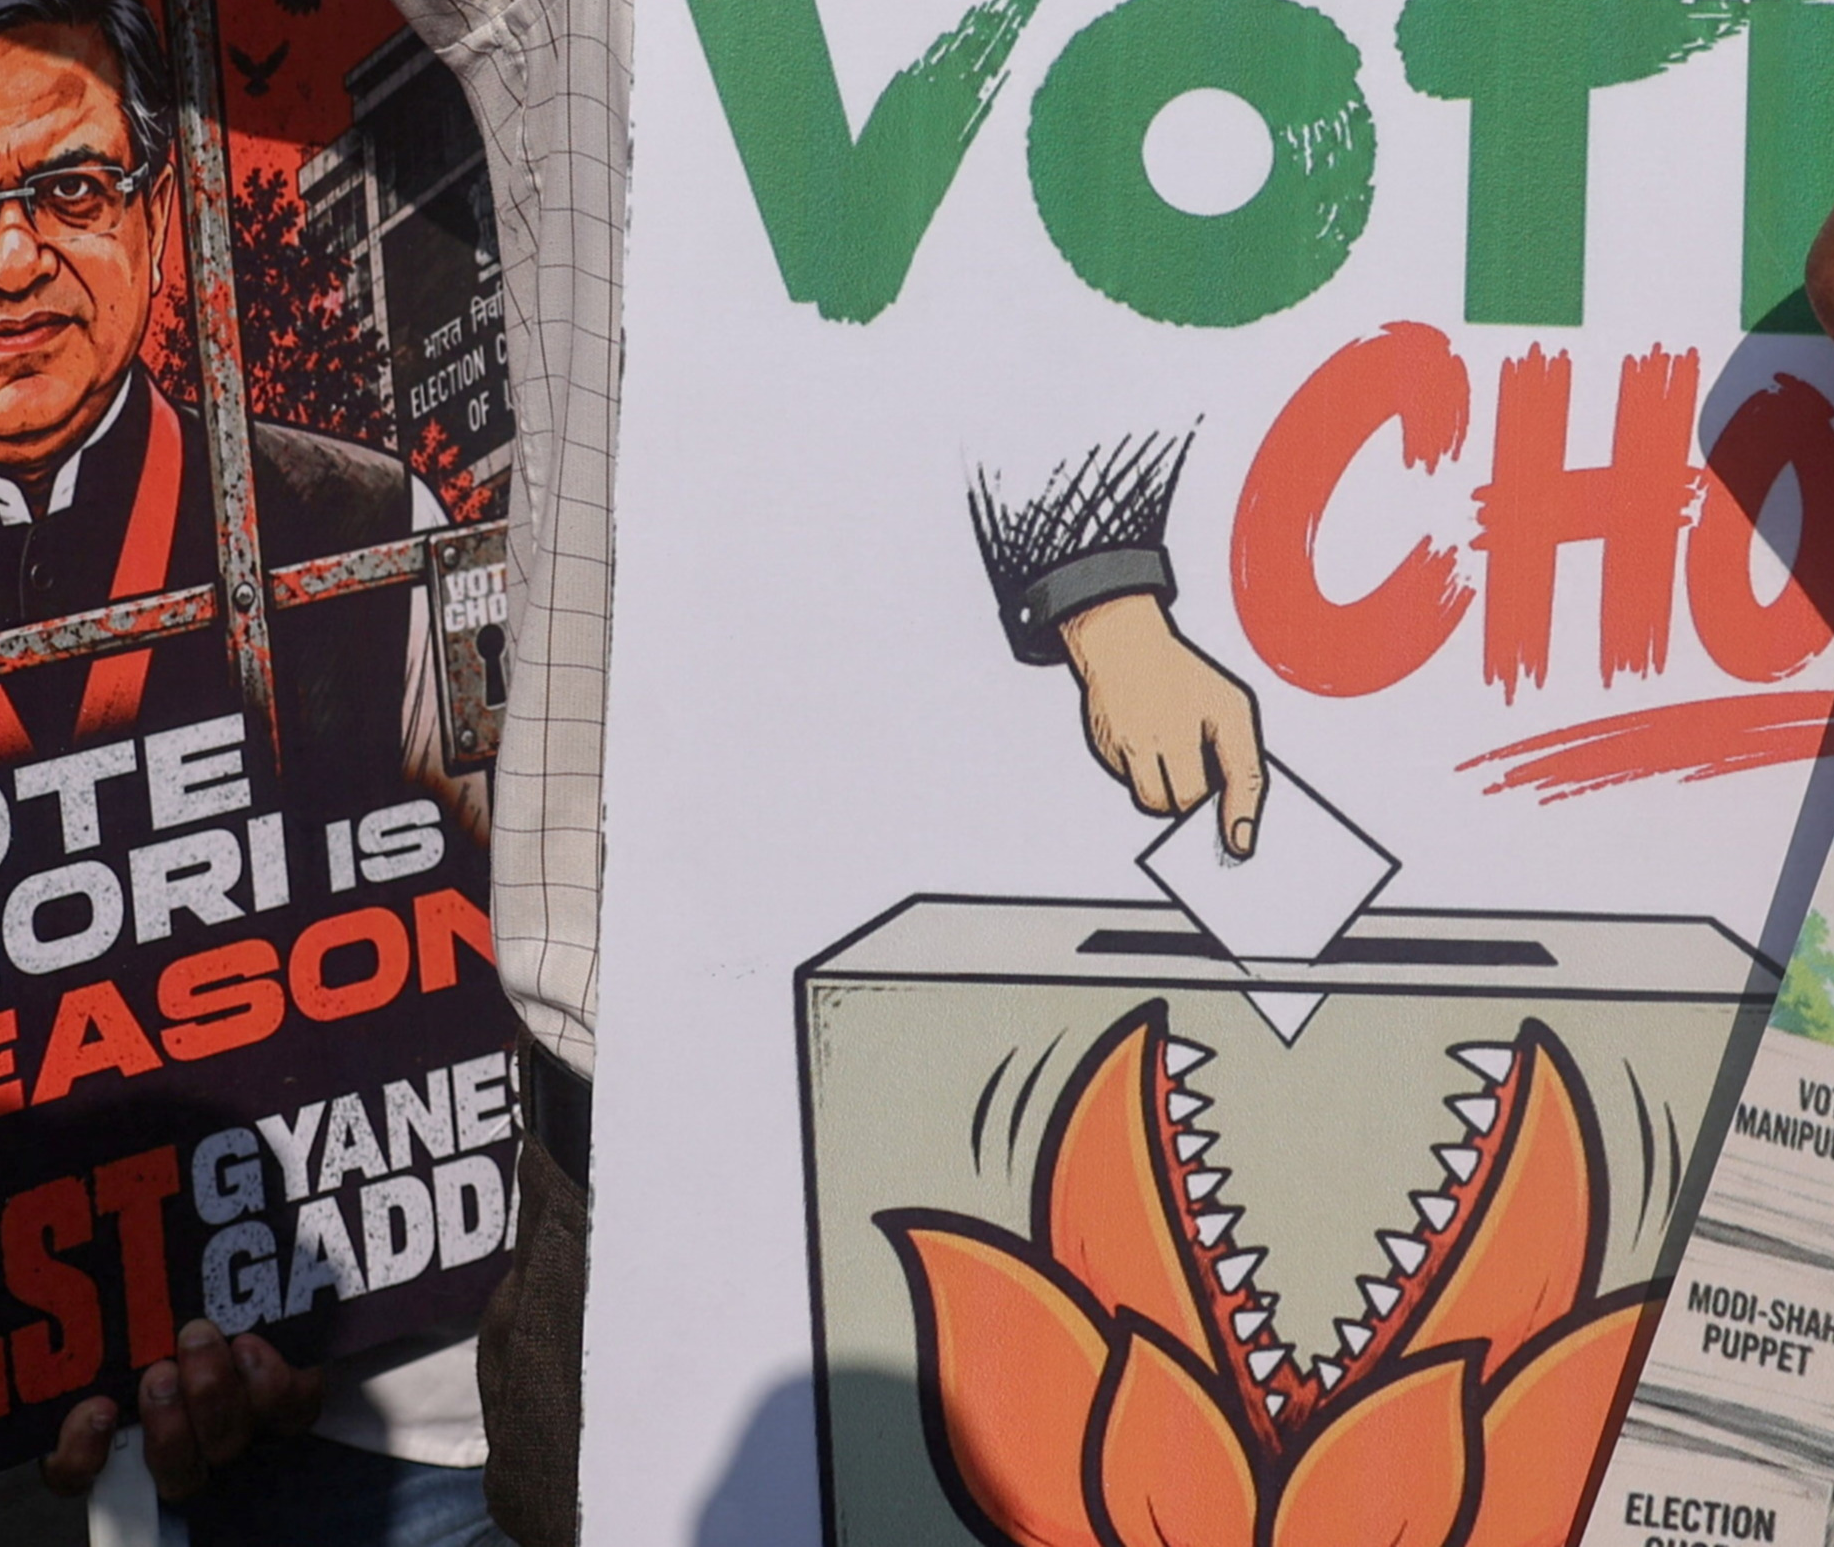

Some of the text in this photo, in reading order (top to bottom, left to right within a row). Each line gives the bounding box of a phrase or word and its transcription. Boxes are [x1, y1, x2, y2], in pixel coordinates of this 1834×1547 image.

[410, 345, 486, 420] ELECTION
[468, 390, 489, 432] OF
[446, 563, 506, 603] VOT
[444, 593, 507, 633] CHO
[327, 799, 446, 892] IS
[191, 1050, 523, 1227] GYANE
[201, 1153, 521, 1337] GADD
[1702, 1323, 1815, 1377] PUPPET
[1624, 1492, 1776, 1543] ELECTION
